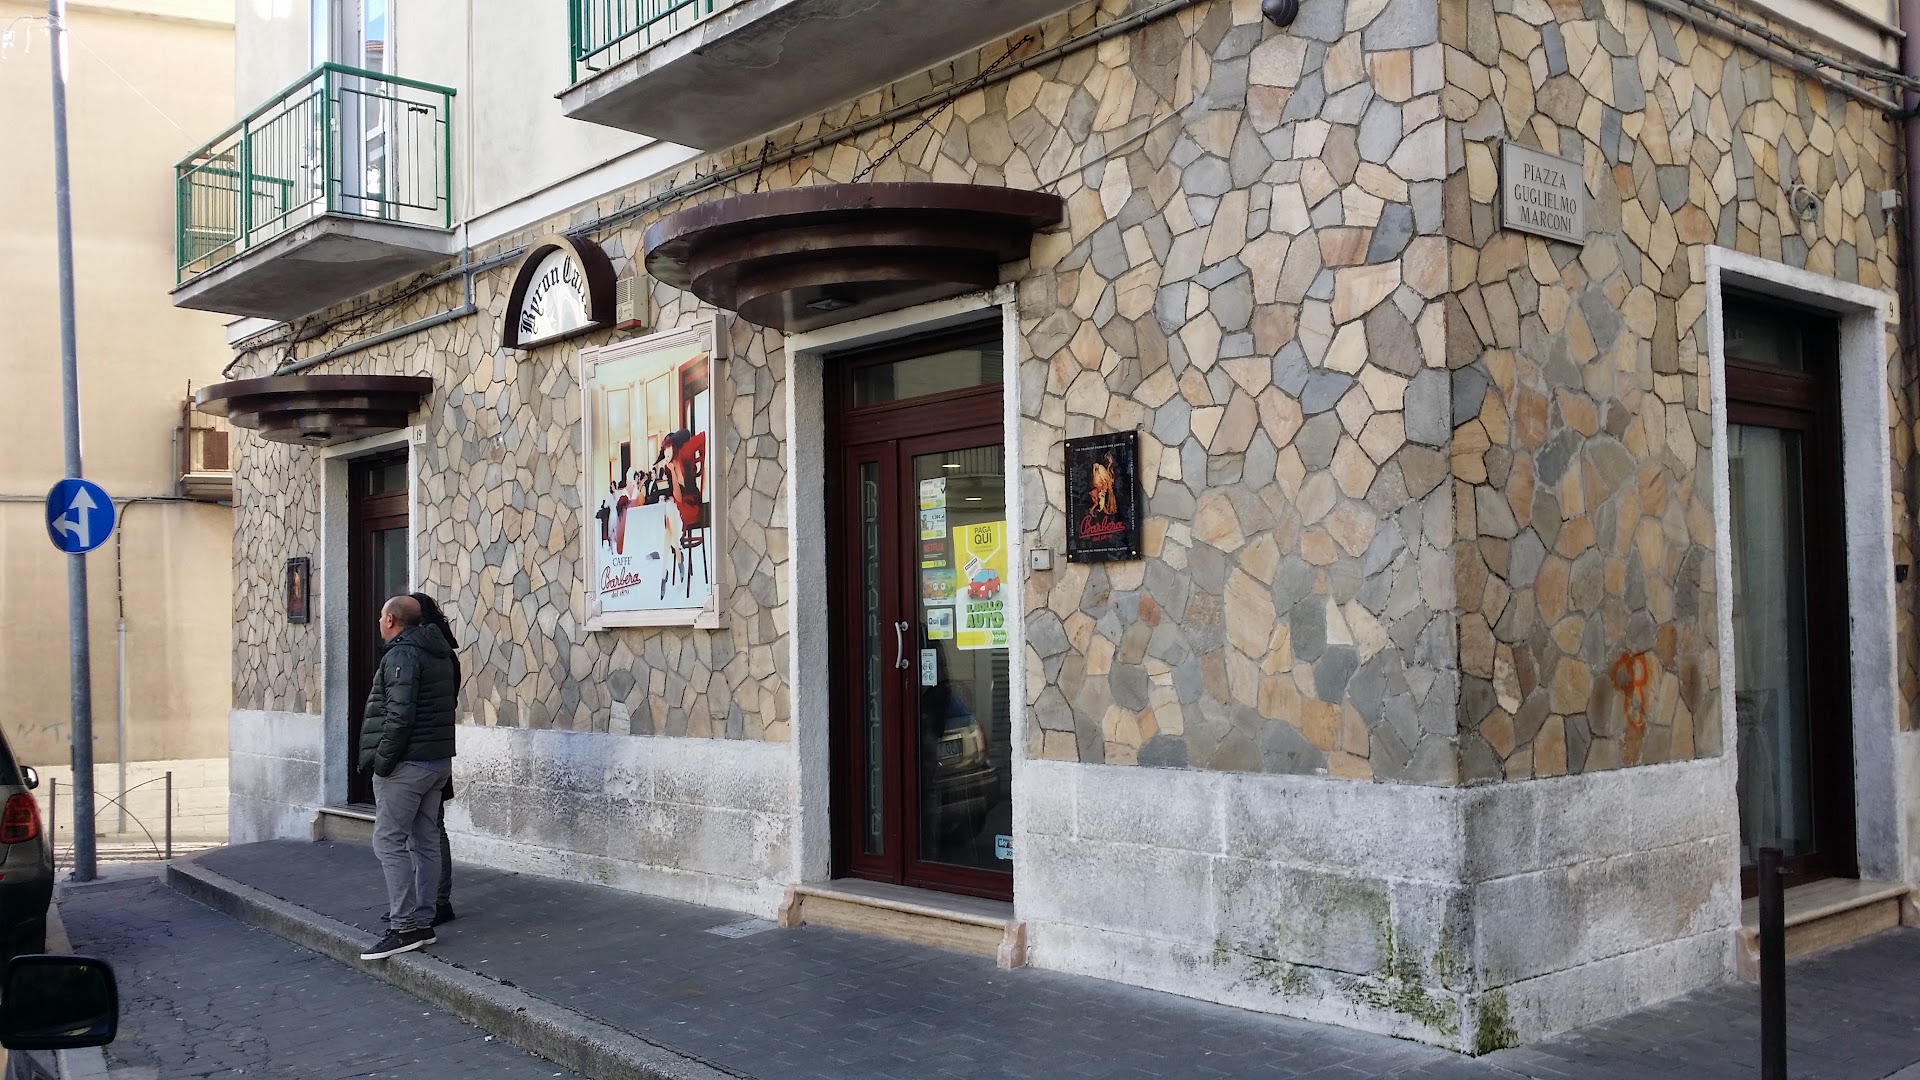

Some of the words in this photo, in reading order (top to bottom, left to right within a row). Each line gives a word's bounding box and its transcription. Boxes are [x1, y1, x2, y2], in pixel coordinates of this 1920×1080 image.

[1524, 163, 1566, 190] PIAZZA
[1514, 183, 1577, 214] GUGLIELMO
[1520, 205, 1571, 233] MARCONI
[520, 267, 559, 335] Byron
[1889, 301, 1894, 318] 9
[974, 526, 992, 534] PAGA
[974, 533, 992, 545] QUI
[966, 611, 1004, 628] AUTO
